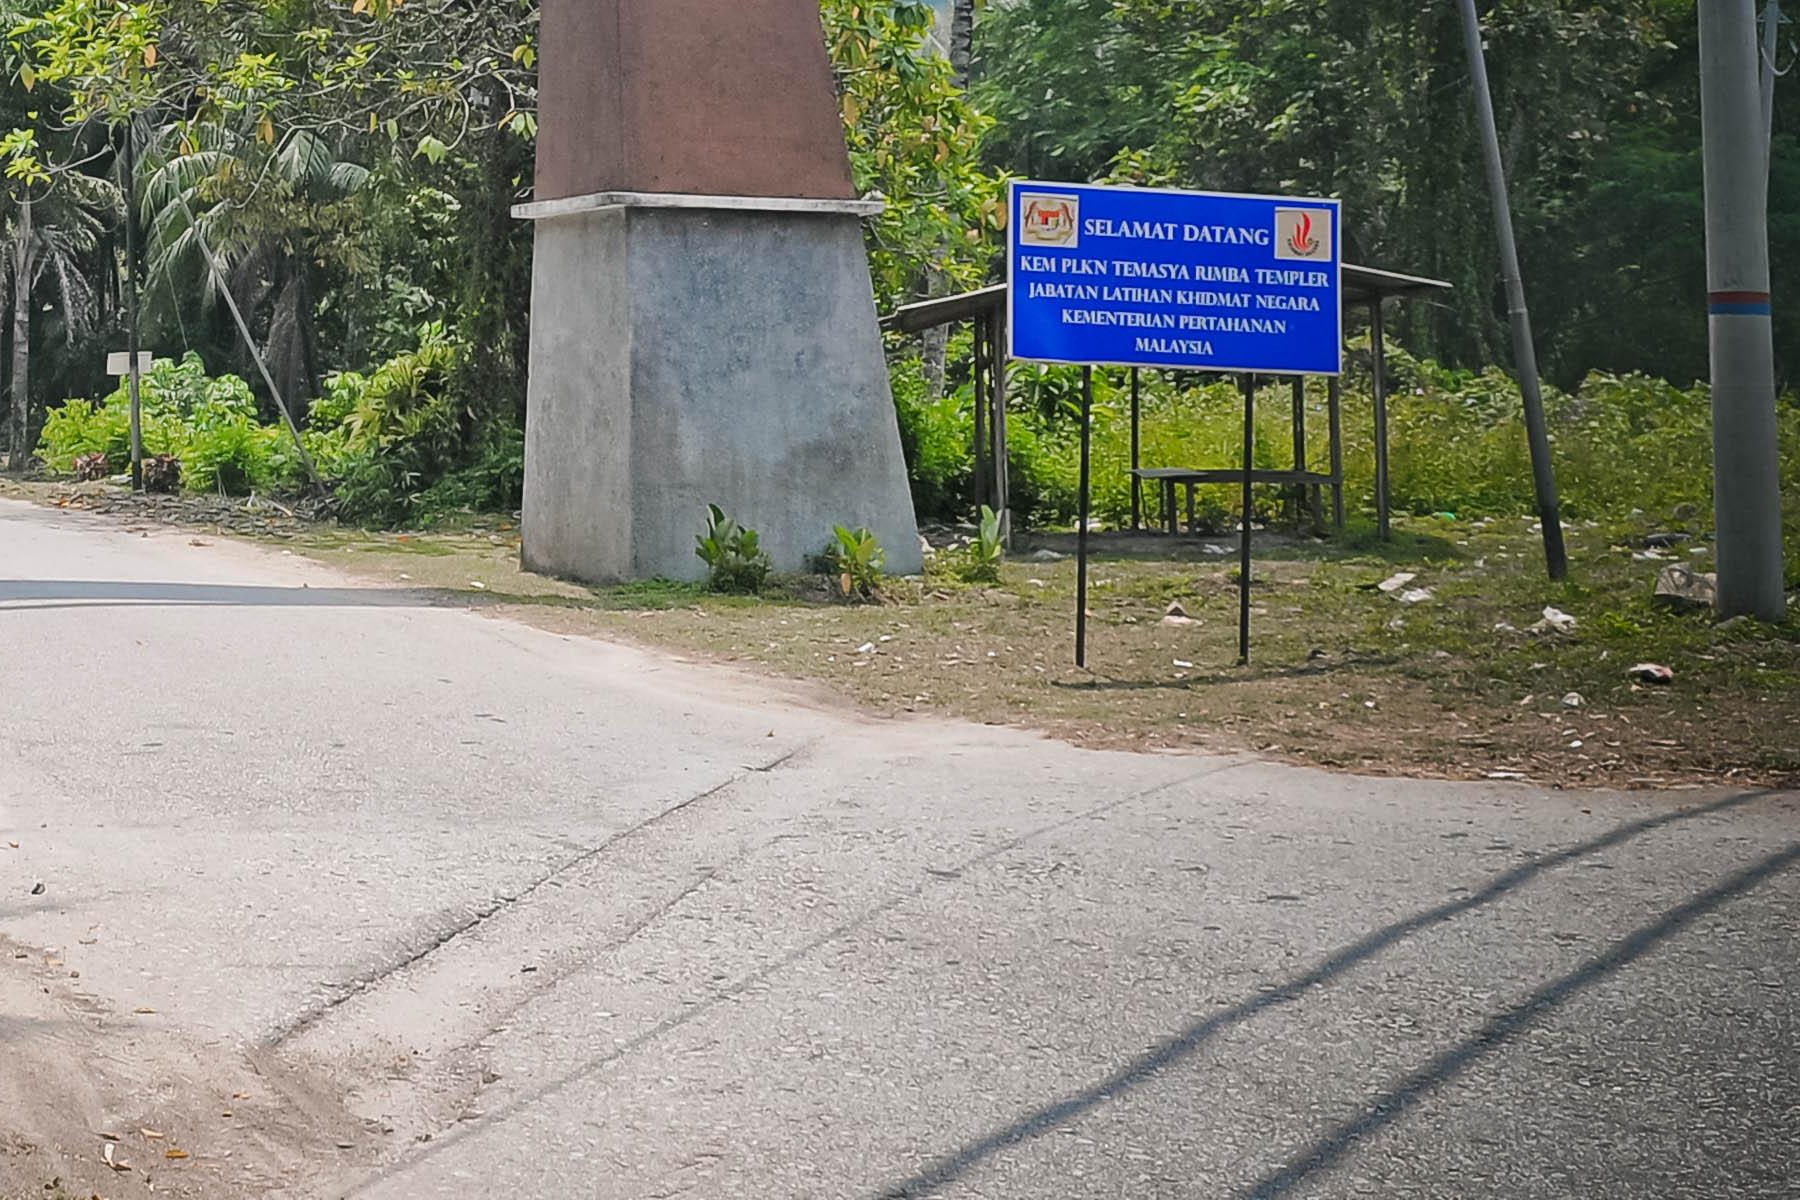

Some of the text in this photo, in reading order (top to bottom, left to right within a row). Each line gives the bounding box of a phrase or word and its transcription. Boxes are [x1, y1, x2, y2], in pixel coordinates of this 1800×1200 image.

[1084, 218, 1270, 246] SELAMAT DATANG
[1020, 255, 1329, 288] KEM PLKN TEMASYA RIMBA TEMPLER
[1028, 282, 1320, 312] JABATAN LATIHAN KHIDMAT NEGARA
[1062, 308, 1287, 334] KEMENTERIAN PERTAHANAN
[1135, 336, 1214, 356] MALAYSIA
